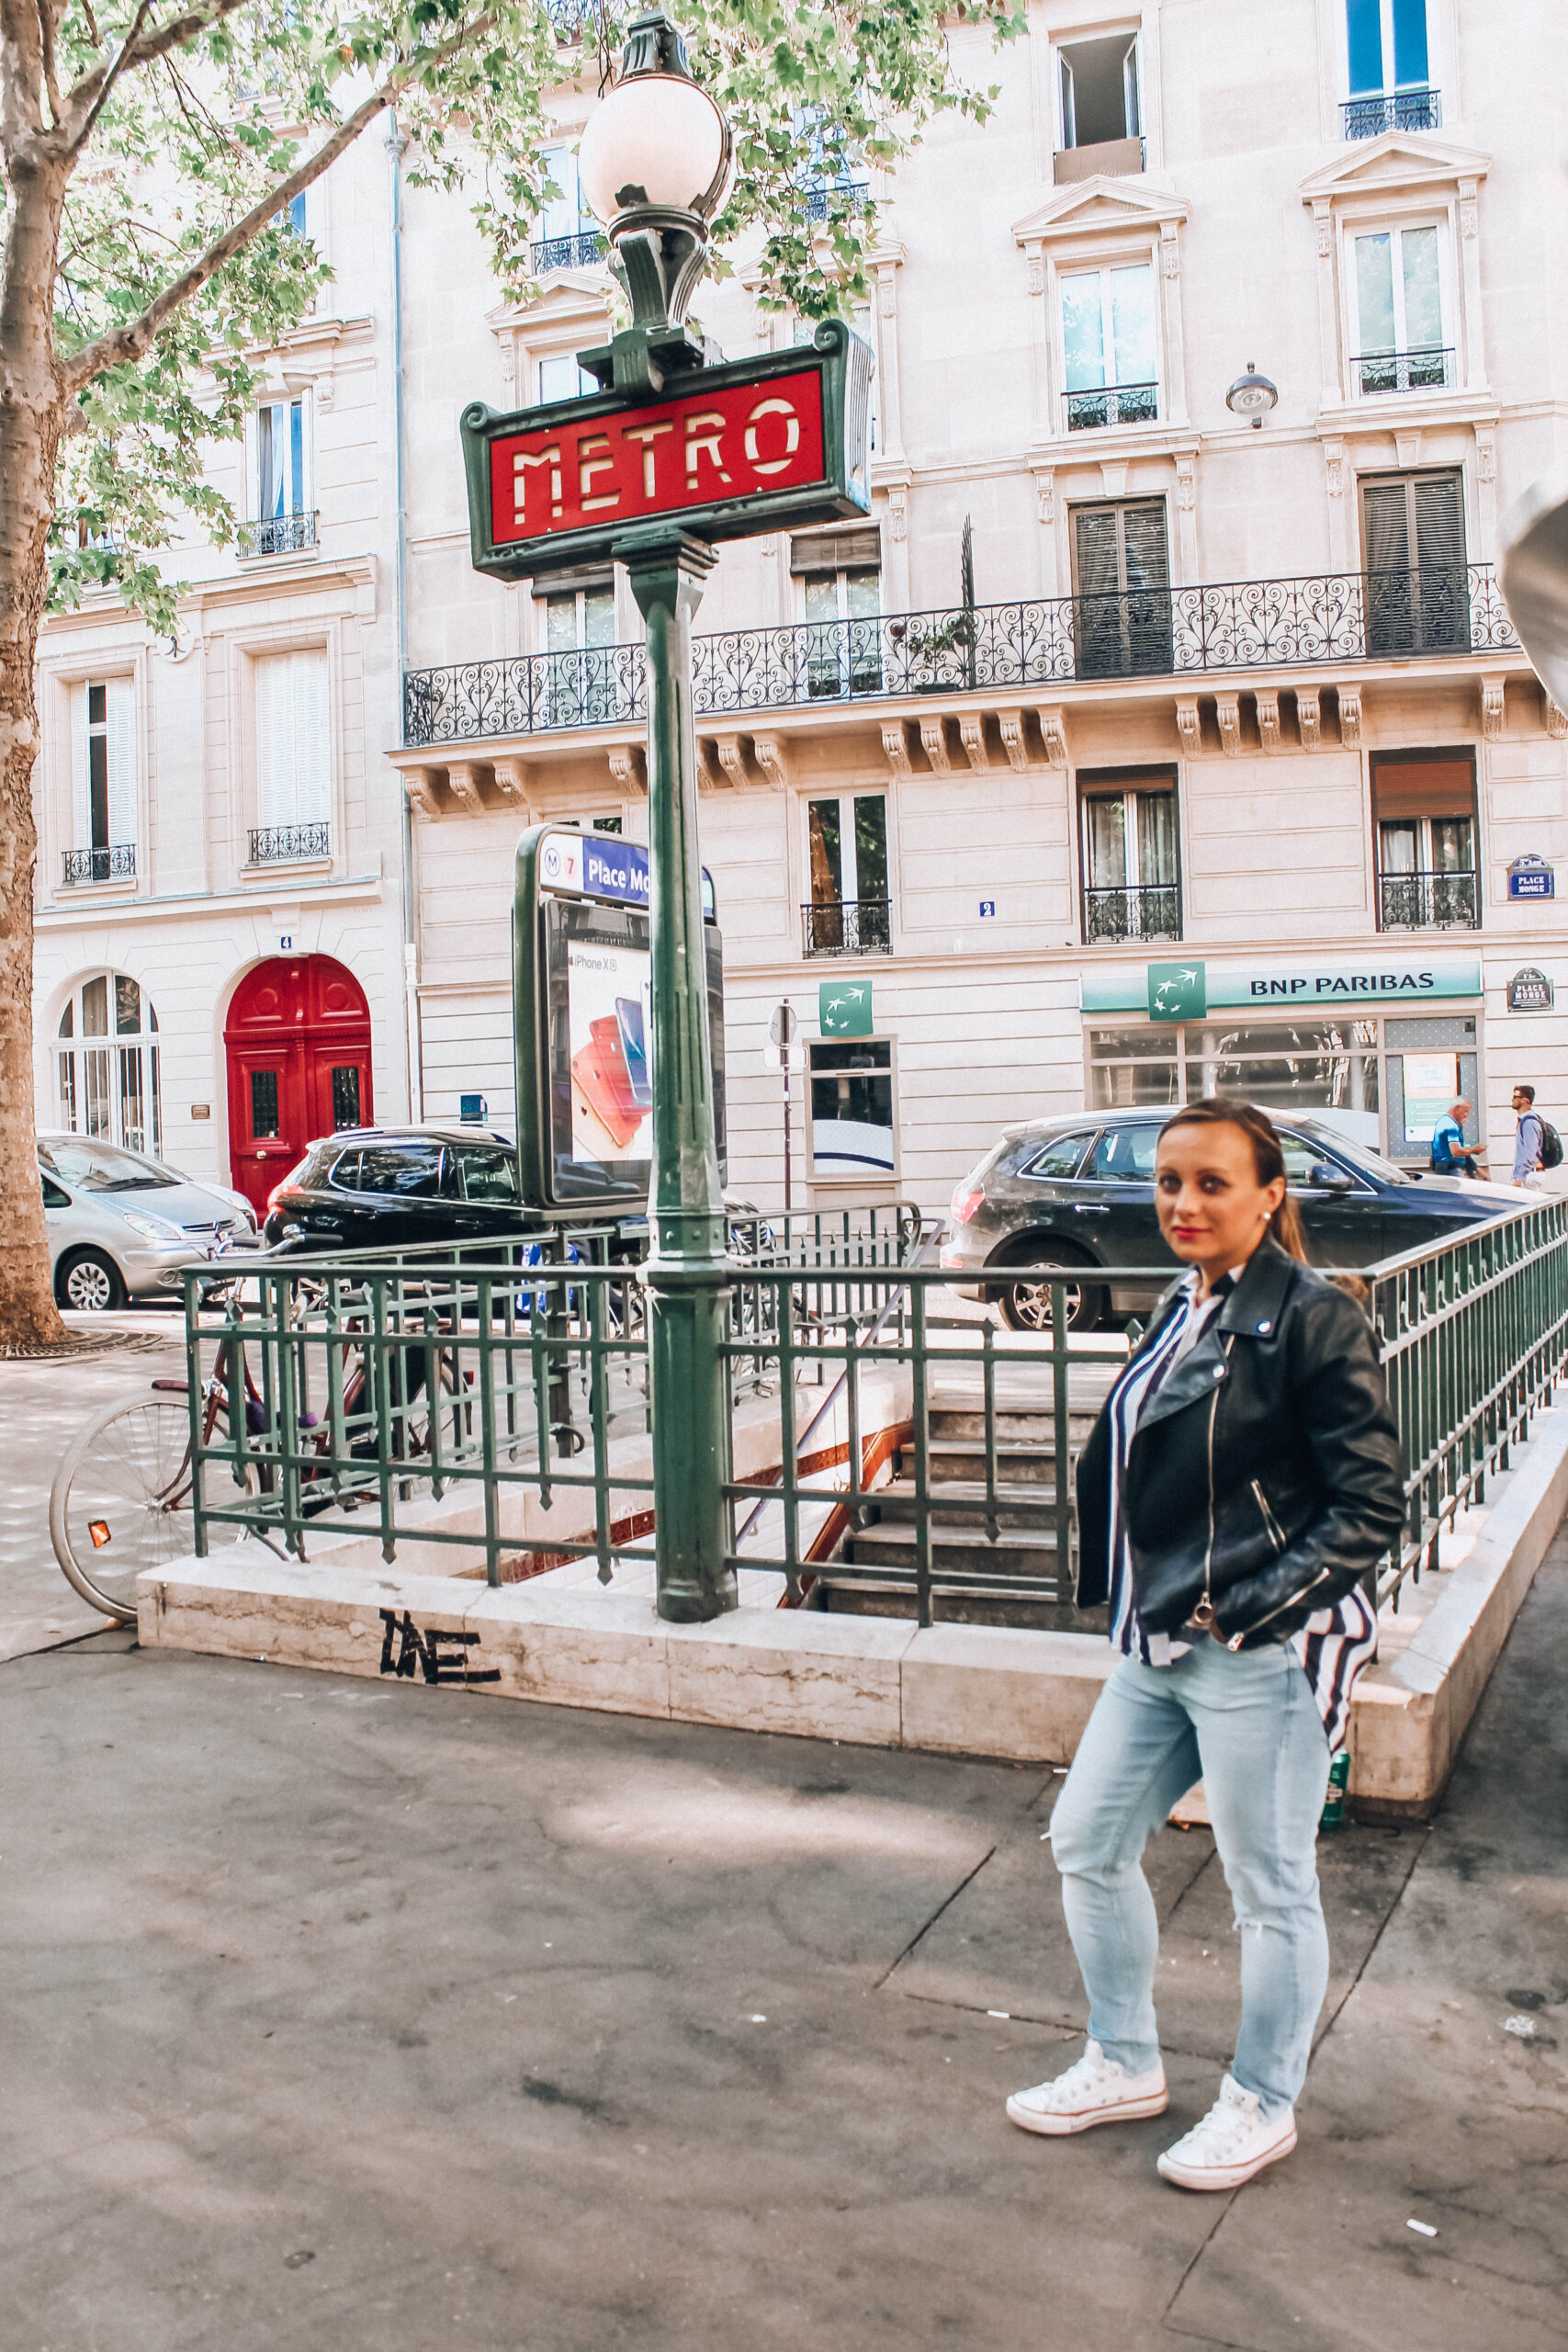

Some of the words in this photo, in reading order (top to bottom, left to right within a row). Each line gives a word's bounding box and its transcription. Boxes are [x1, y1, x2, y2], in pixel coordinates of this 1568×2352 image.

[512, 398, 800, 526] METRO
[567, 857, 575, 875] 7
[588, 858, 626, 888] Place
[1517, 876, 1545, 885] PLACE
[1517, 885, 1545, 894] MONGE
[983, 902, 992, 916] 2
[283, 937, 290, 948] 4
[574, 955, 603, 970] iPhone
[1250, 978, 1307, 996] BNP
[1315, 972, 1435, 993] PARIBAS
[1517, 984, 1544, 992] PLACE
[1515, 991, 1547, 1000] MONGE
